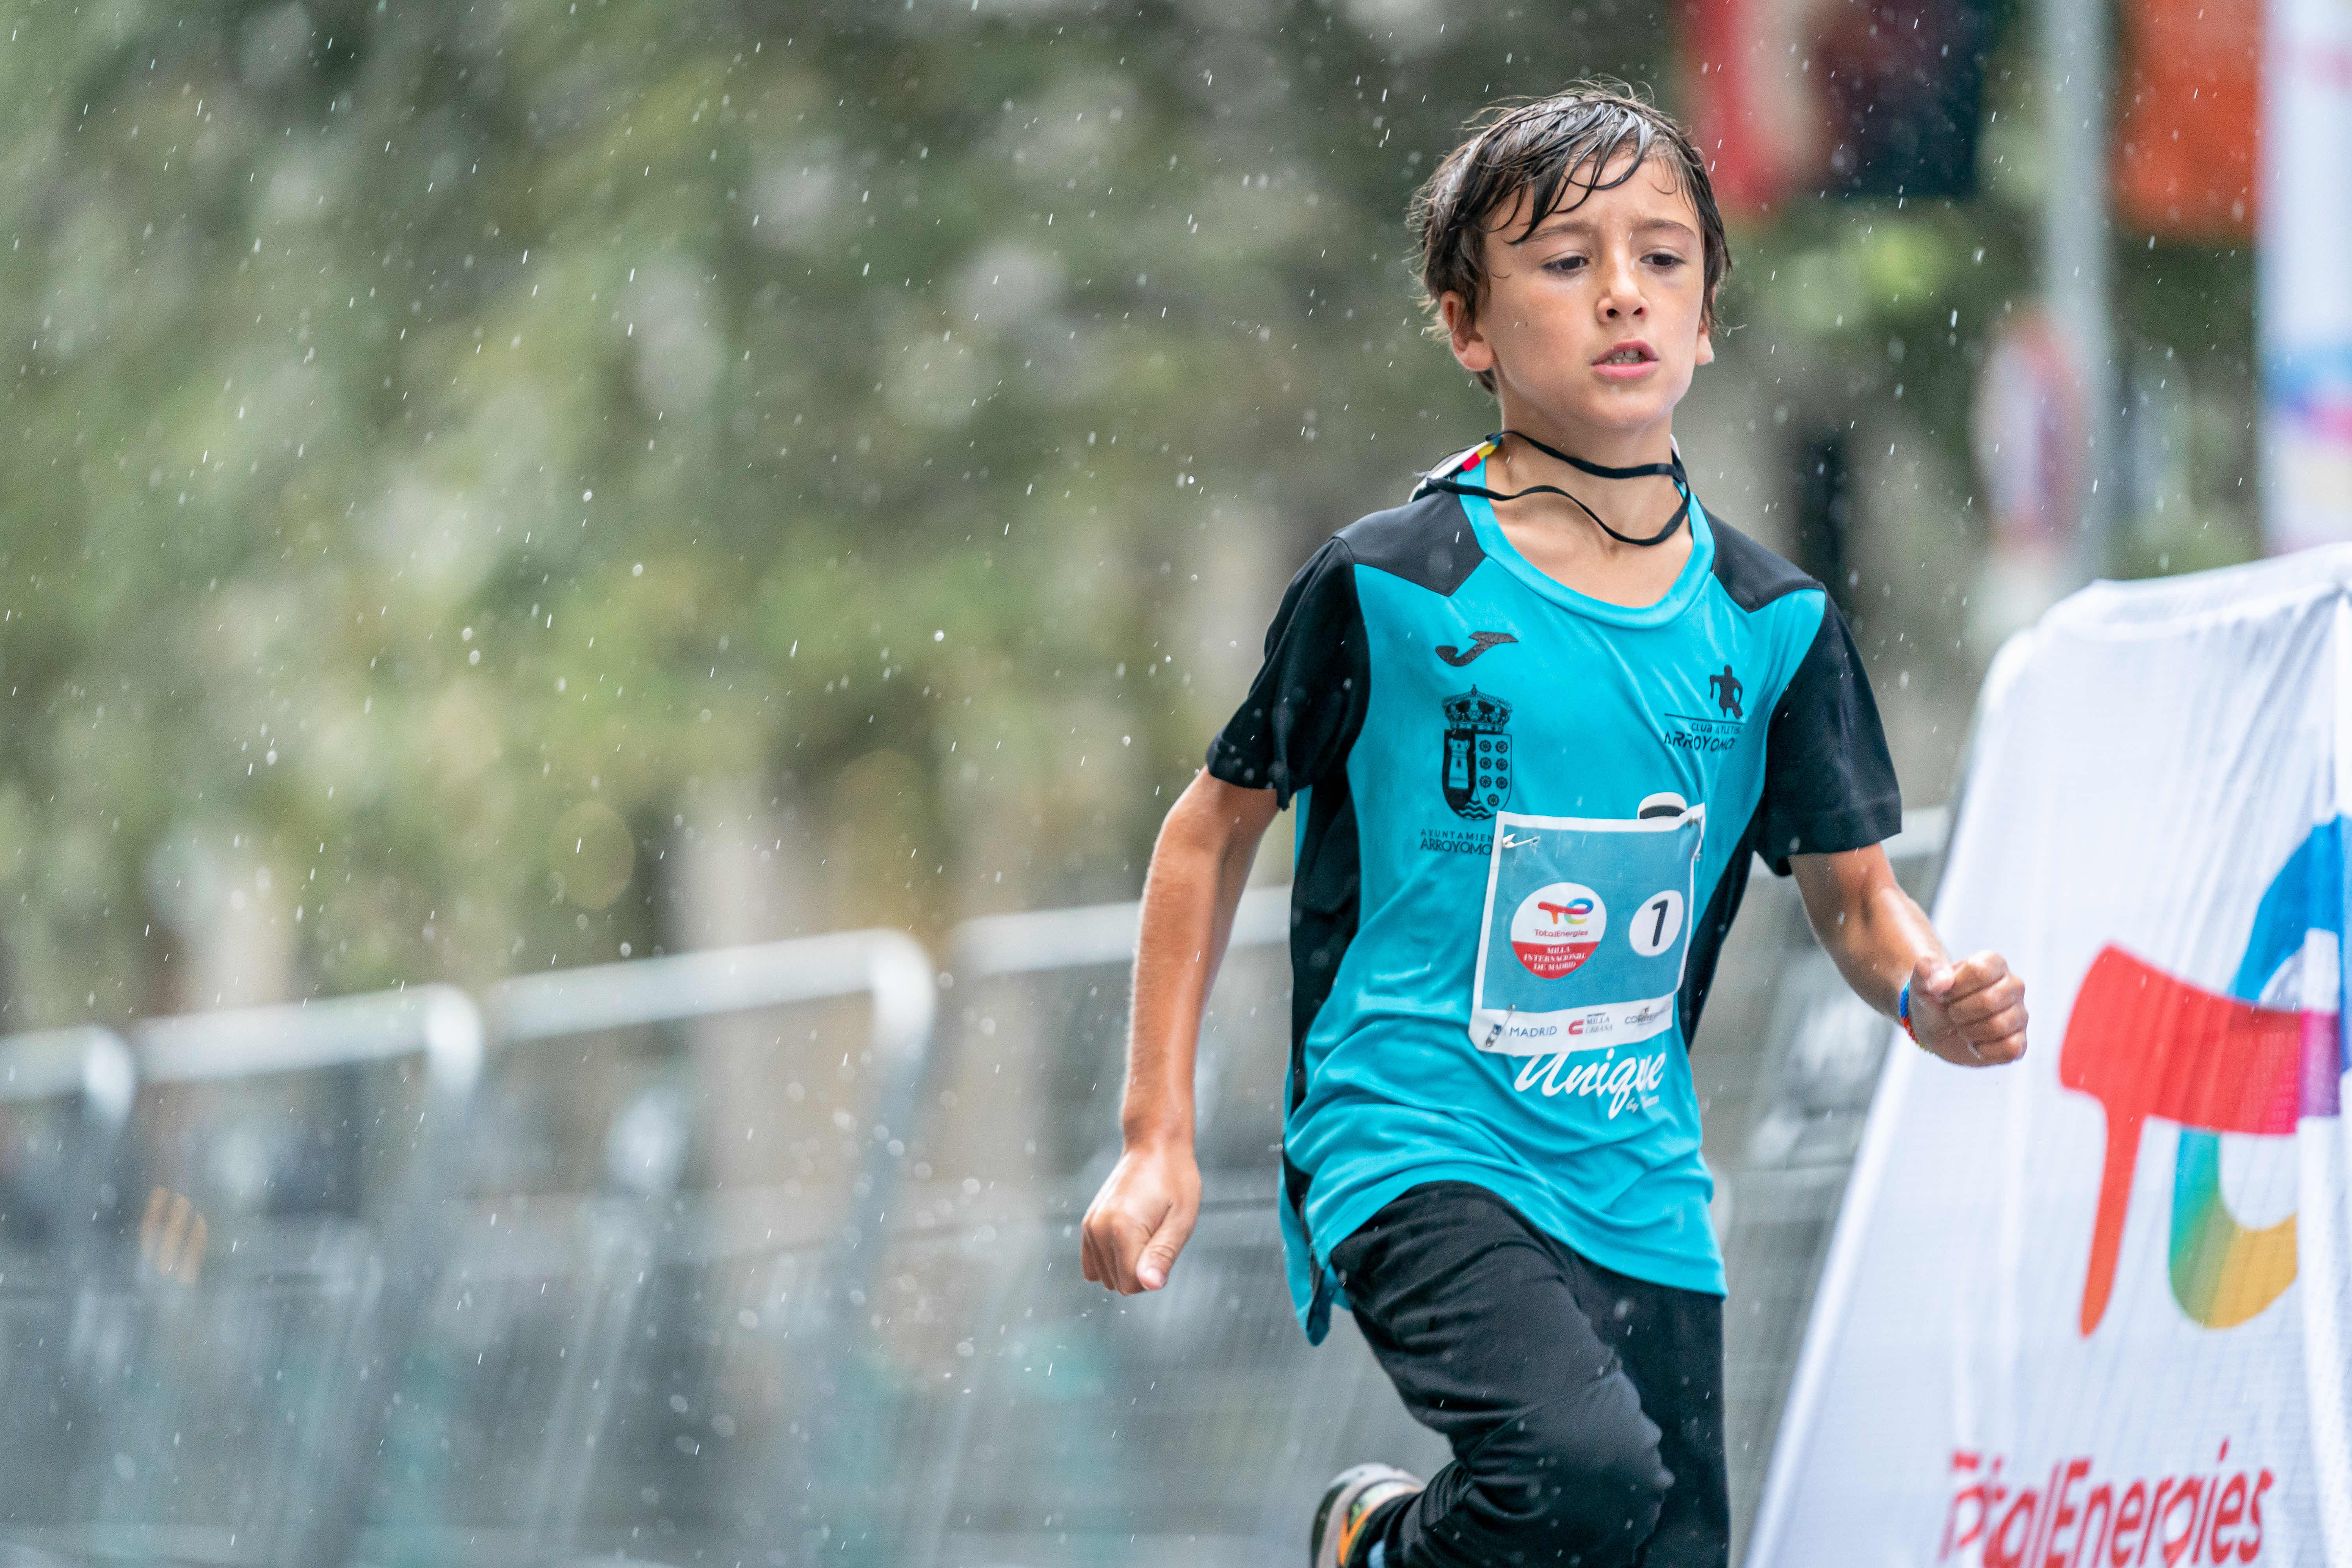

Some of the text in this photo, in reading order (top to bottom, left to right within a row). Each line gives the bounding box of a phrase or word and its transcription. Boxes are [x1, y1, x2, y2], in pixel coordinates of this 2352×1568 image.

[1691, 722, 1713, 732] CLUB
[1421, 828, 1494, 842] AYUNTAMIEN
[1420, 838, 1493, 855] ARROYOMO
[1652, 899, 1669, 947] 1
[1534, 928, 1589, 938] TotalEnergies
[1548, 961, 1576, 970] MADRID
[1510, 1025, 1557, 1038] MADRID
[1514, 1047, 1666, 1120] Unique
